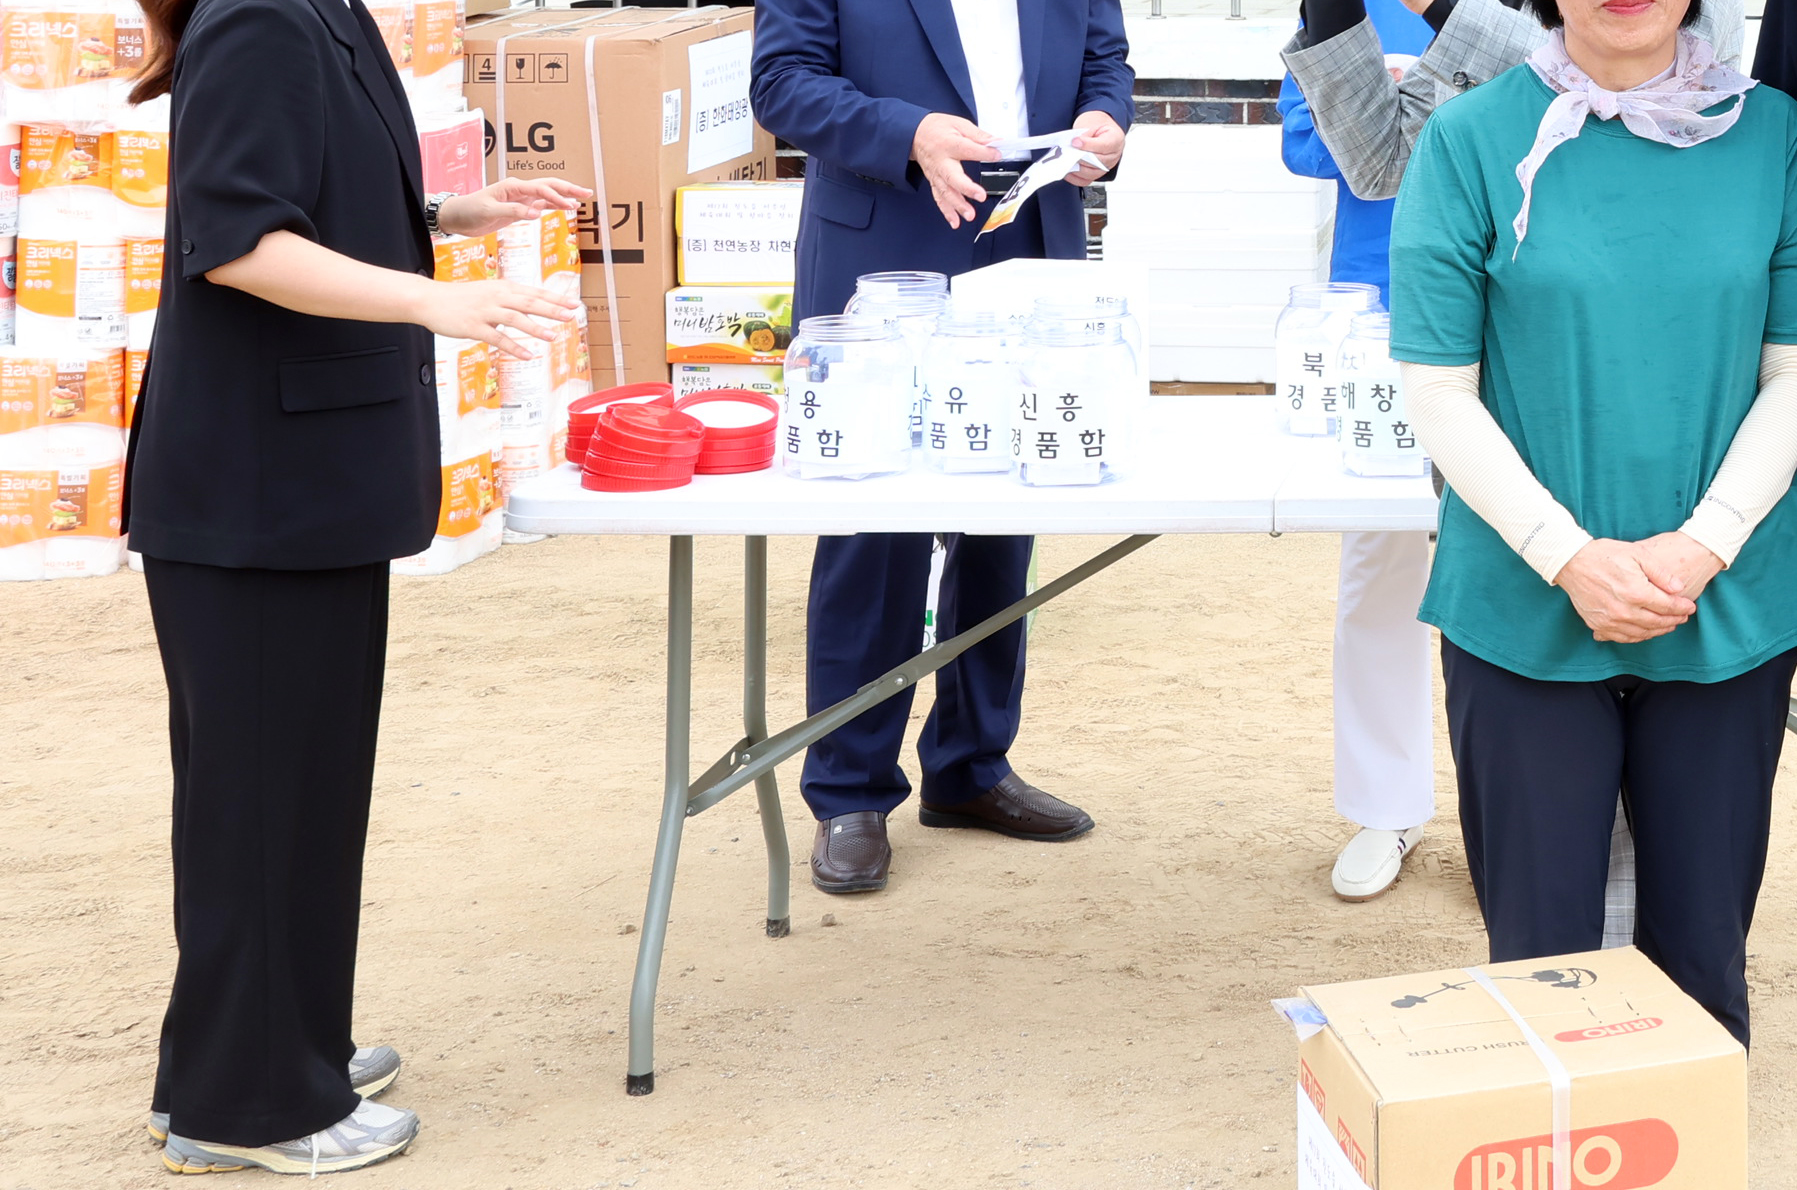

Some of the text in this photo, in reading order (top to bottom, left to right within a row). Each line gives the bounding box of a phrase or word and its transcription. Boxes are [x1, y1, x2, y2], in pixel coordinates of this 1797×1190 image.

[10, 22, 78, 39] 크리넥스
[117, 35, 143, 45] 보너스
[505, 122, 555, 153] LG
[507, 160, 565, 171] Life's Good
[26, 246, 74, 259] 크리넥스
[713, 239, 761, 252] 천연농장
[1302, 352, 1325, 377] 북
[1581, 1017, 1656, 1039] IRINO
[1407, 1038, 1544, 1058] RUSH CUTTER
